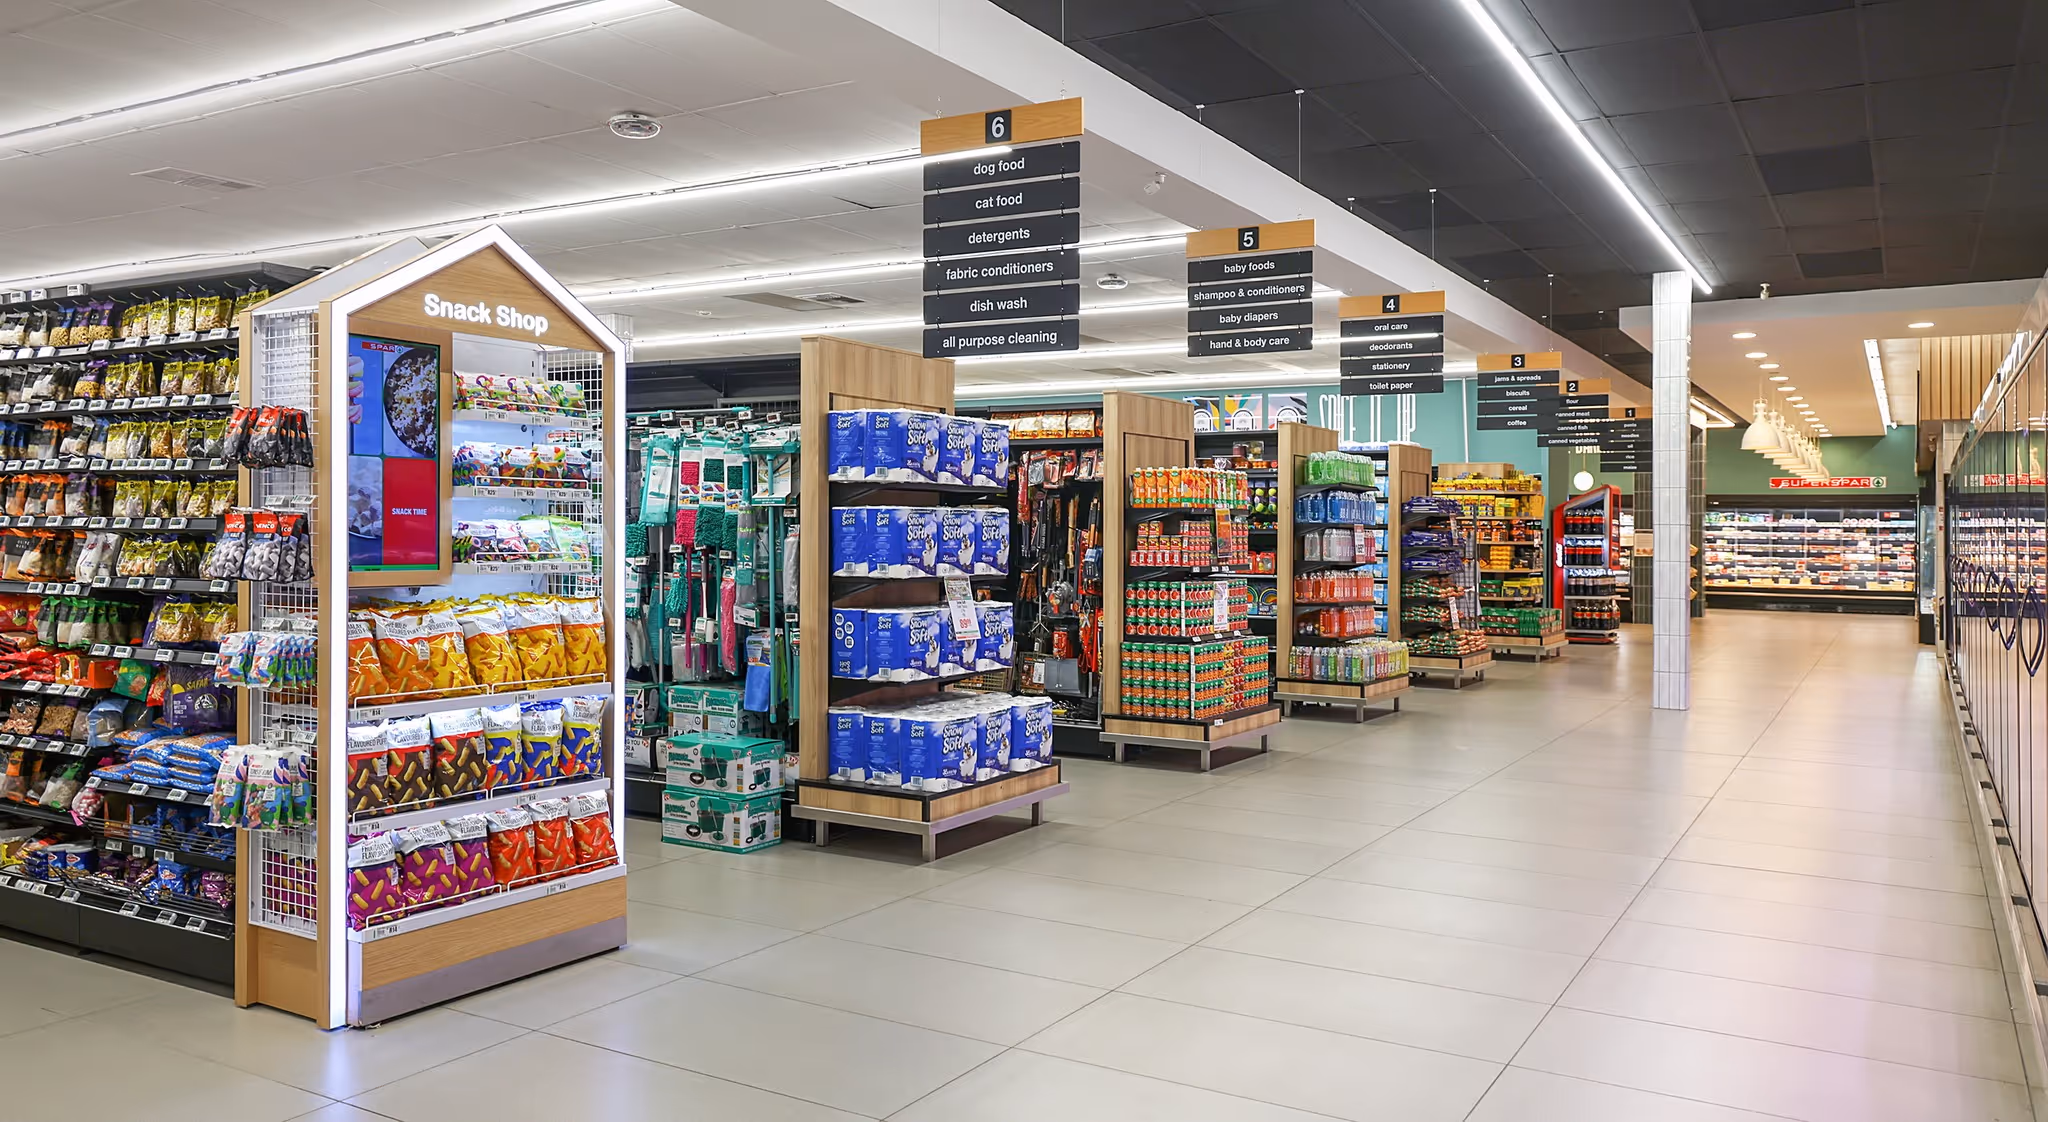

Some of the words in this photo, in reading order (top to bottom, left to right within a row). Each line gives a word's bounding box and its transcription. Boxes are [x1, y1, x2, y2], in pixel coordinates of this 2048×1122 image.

[991, 116, 1004, 138] 6
[973, 163, 995, 176] dog
[998, 157, 1025, 172] food
[975, 196, 993, 209] cat
[996, 192, 1023, 207] food
[968, 227, 1030, 245] detergents
[1242, 231, 1254, 247] 5
[946, 266, 979, 280] fabric
[981, 261, 1054, 277] conditioners
[1224, 263, 1247, 274] baby
[1248, 260, 1275, 272] foods
[1194, 289, 1236, 301] shampoo
[1238, 288, 1245, 297] &
[1247, 284, 1305, 297] conditioners
[970, 299, 994, 312] dish
[997, 296, 1028, 310] wash
[1386, 298, 1395, 311] 4
[424, 293, 492, 325] Snack
[496, 305, 549, 336] Shop
[1219, 313, 1242, 324] baby
[1244, 312, 1279, 323] diapers
[1374, 323, 1390, 332] oral
[1391, 323, 1408, 331] care
[370, 343, 394, 351] SPAR
[943, 336, 956, 348] all
[958, 335, 1005, 350] purpose
[1008, 330, 1058, 345] cleaning
[1209, 339, 1233, 349] hand
[1234, 338, 1242, 348] &
[1244, 337, 1267, 348] body
[1269, 336, 1290, 346] care
[1369, 341, 1413, 351] deodorants
[1371, 362, 1411, 371] stationery
[1514, 356, 1522, 367] 3
[1494, 375, 1510, 383] jams
[1516, 374, 1541, 383] spreads
[1369, 382, 1389, 390] toilet
[1390, 382, 1413, 391] paper
[1569, 382, 1576, 391] 2
[1370, 395, 1384, 442] IT
[1396, 393, 1416, 442] UP
[1627, 409, 1632, 417] 1
[907, 416, 927, 430] Snow
[947, 421, 965, 435] Snow
[907, 430, 928, 446] Soft
[982, 427, 999, 440] Snow
[947, 434, 966, 450] Soft
[981, 439, 999, 453] Soft
[1781, 478, 1870, 487] SUPERSPAR
[391, 507, 412, 516] SNACK
[413, 508, 427, 516] TIME
[907, 513, 925, 526] Snow
[943, 513, 961, 526] Snow
[982, 515, 999, 528] Snow
[907, 526, 926, 541] Soft
[943, 526, 962, 541] Soft
[982, 527, 1000, 541] Soft
[910, 617, 928, 629] Snow
[985, 611, 1001, 623] Snow
[910, 629, 929, 645] Soft
[985, 622, 1002, 638] Soft
[986, 715, 1001, 729] Snow
[1025, 709, 1044, 722] Snow
[943, 724, 964, 739] Snow
[986, 727, 1000, 744] Soft
[1025, 720, 1043, 737] Soft
[943, 737, 964, 754] Soft
